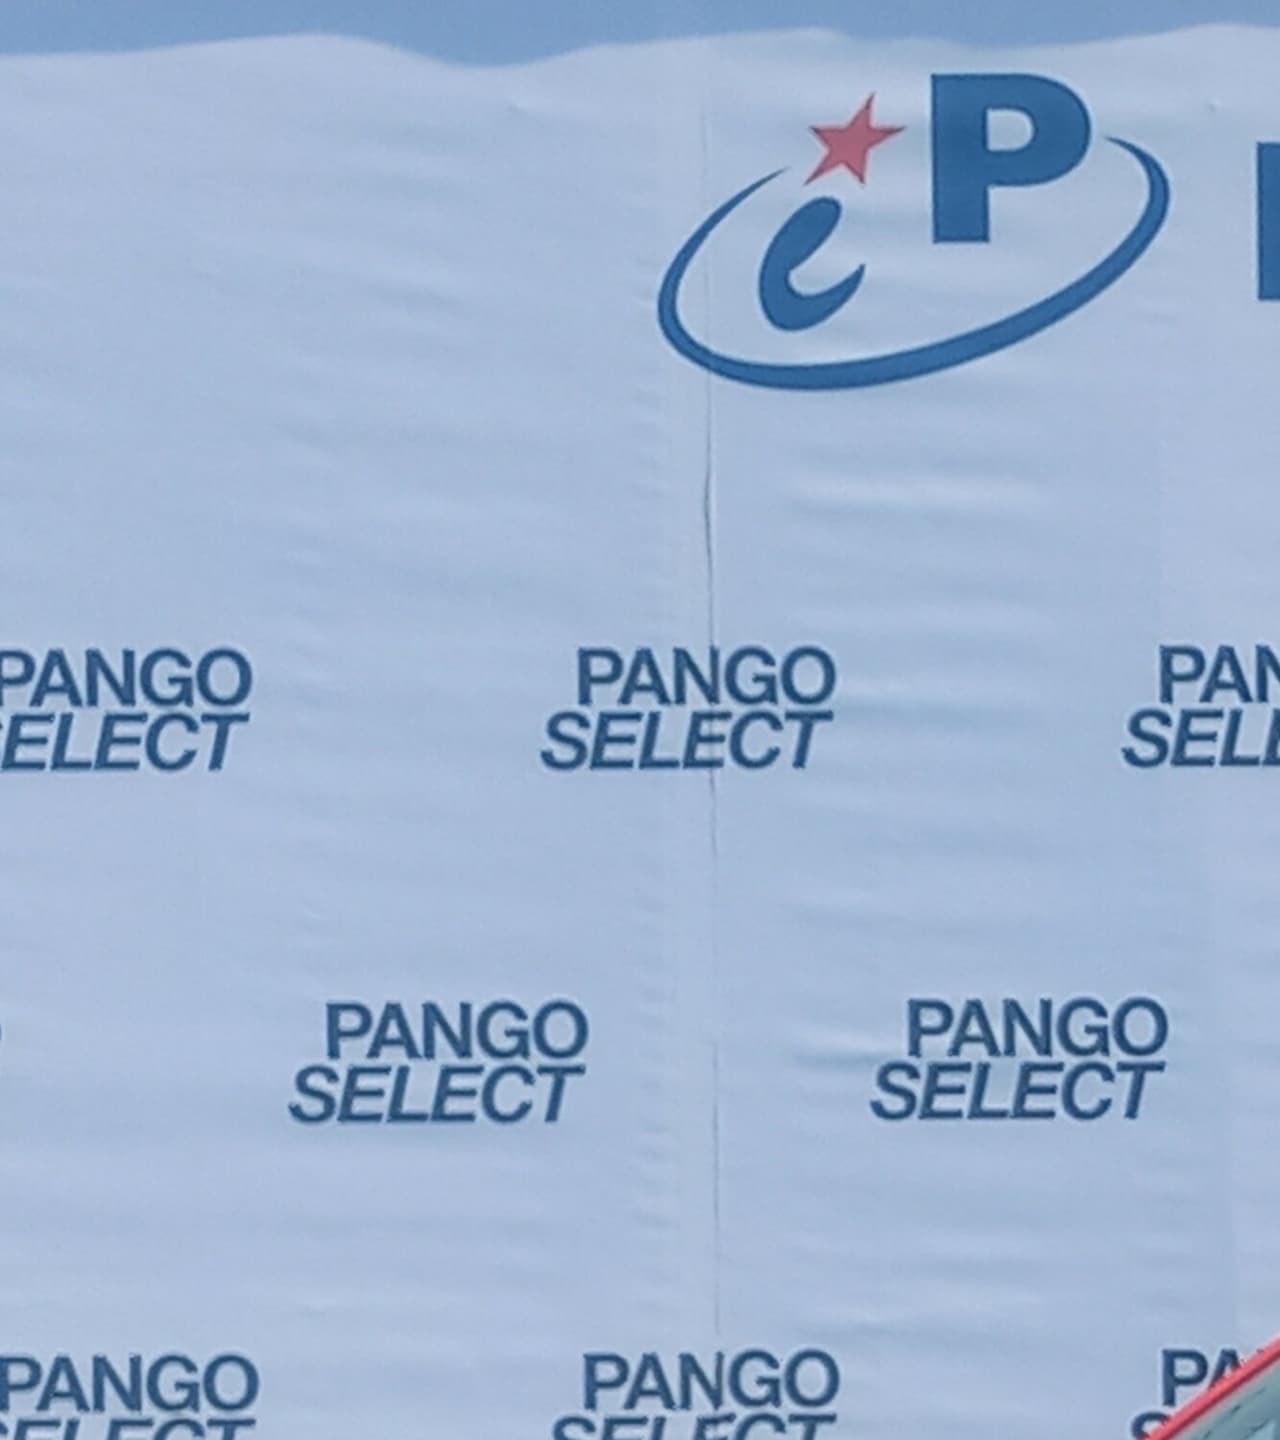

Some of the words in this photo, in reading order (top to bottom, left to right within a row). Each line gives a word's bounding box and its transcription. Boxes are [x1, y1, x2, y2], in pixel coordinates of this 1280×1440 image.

[0, 648, 253, 708] PANGO
[577, 644, 837, 707] PANGO
[0, 711, 251, 773] ELECT
[540, 708, 835, 772] SELECT
[326, 1000, 590, 1061] PANGO
[907, 996, 1169, 1059] PANGO
[288, 1062, 588, 1126] SELECT
[870, 1059, 1167, 1122] SELECT
[0, 1354, 260, 1414] PANGO
[583, 1349, 841, 1411] PANGO
